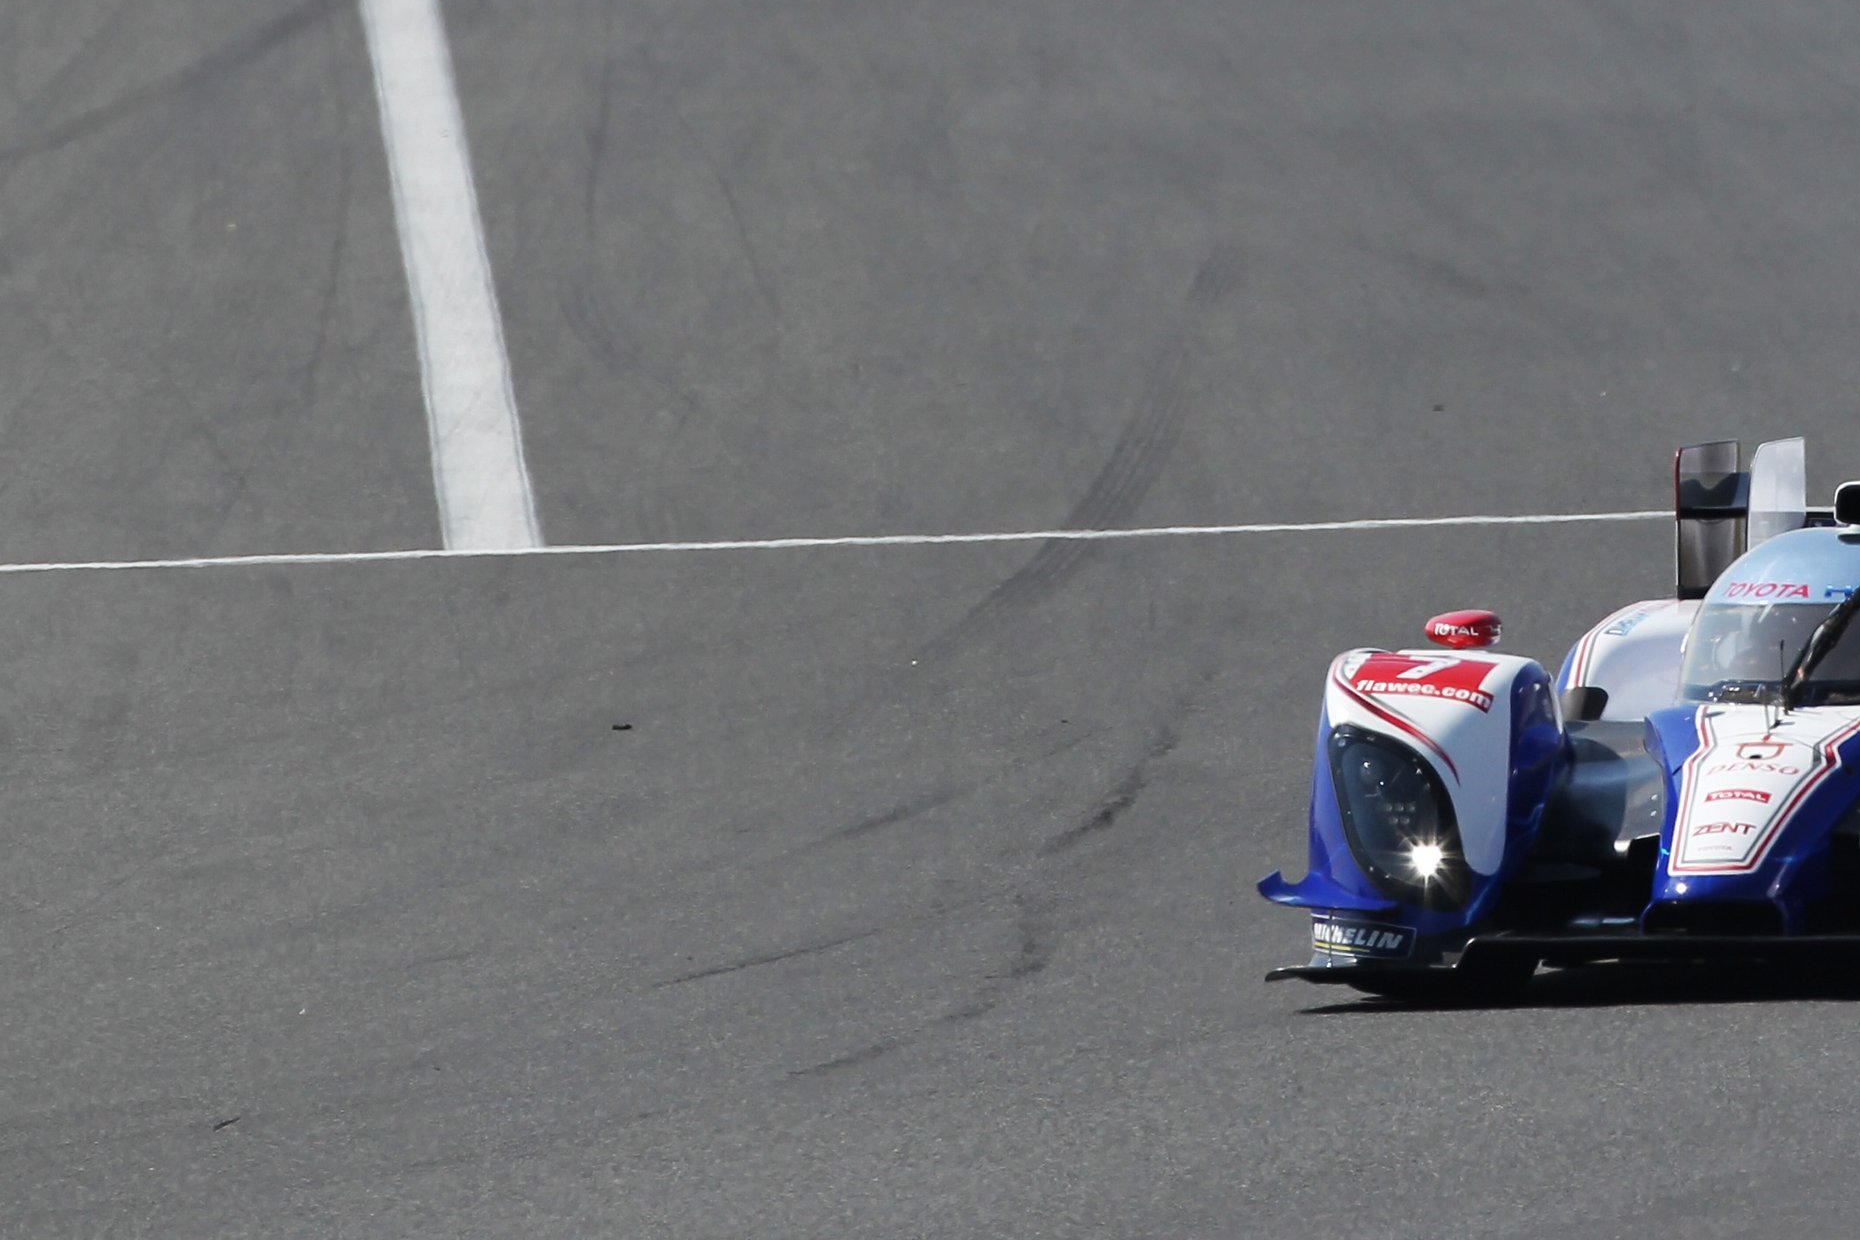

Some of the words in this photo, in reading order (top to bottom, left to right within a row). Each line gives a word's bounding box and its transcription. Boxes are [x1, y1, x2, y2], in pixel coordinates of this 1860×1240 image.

[1722, 582, 1809, 599] TOYOTA
[1434, 622, 1479, 636] TOTAL
[1396, 655, 1462, 680] 7
[1356, 679, 1492, 710] fiawec.com
[1706, 762, 1800, 776] DENSO
[1709, 792, 1767, 802] TOTAL
[1692, 821, 1757, 837] ZENT
